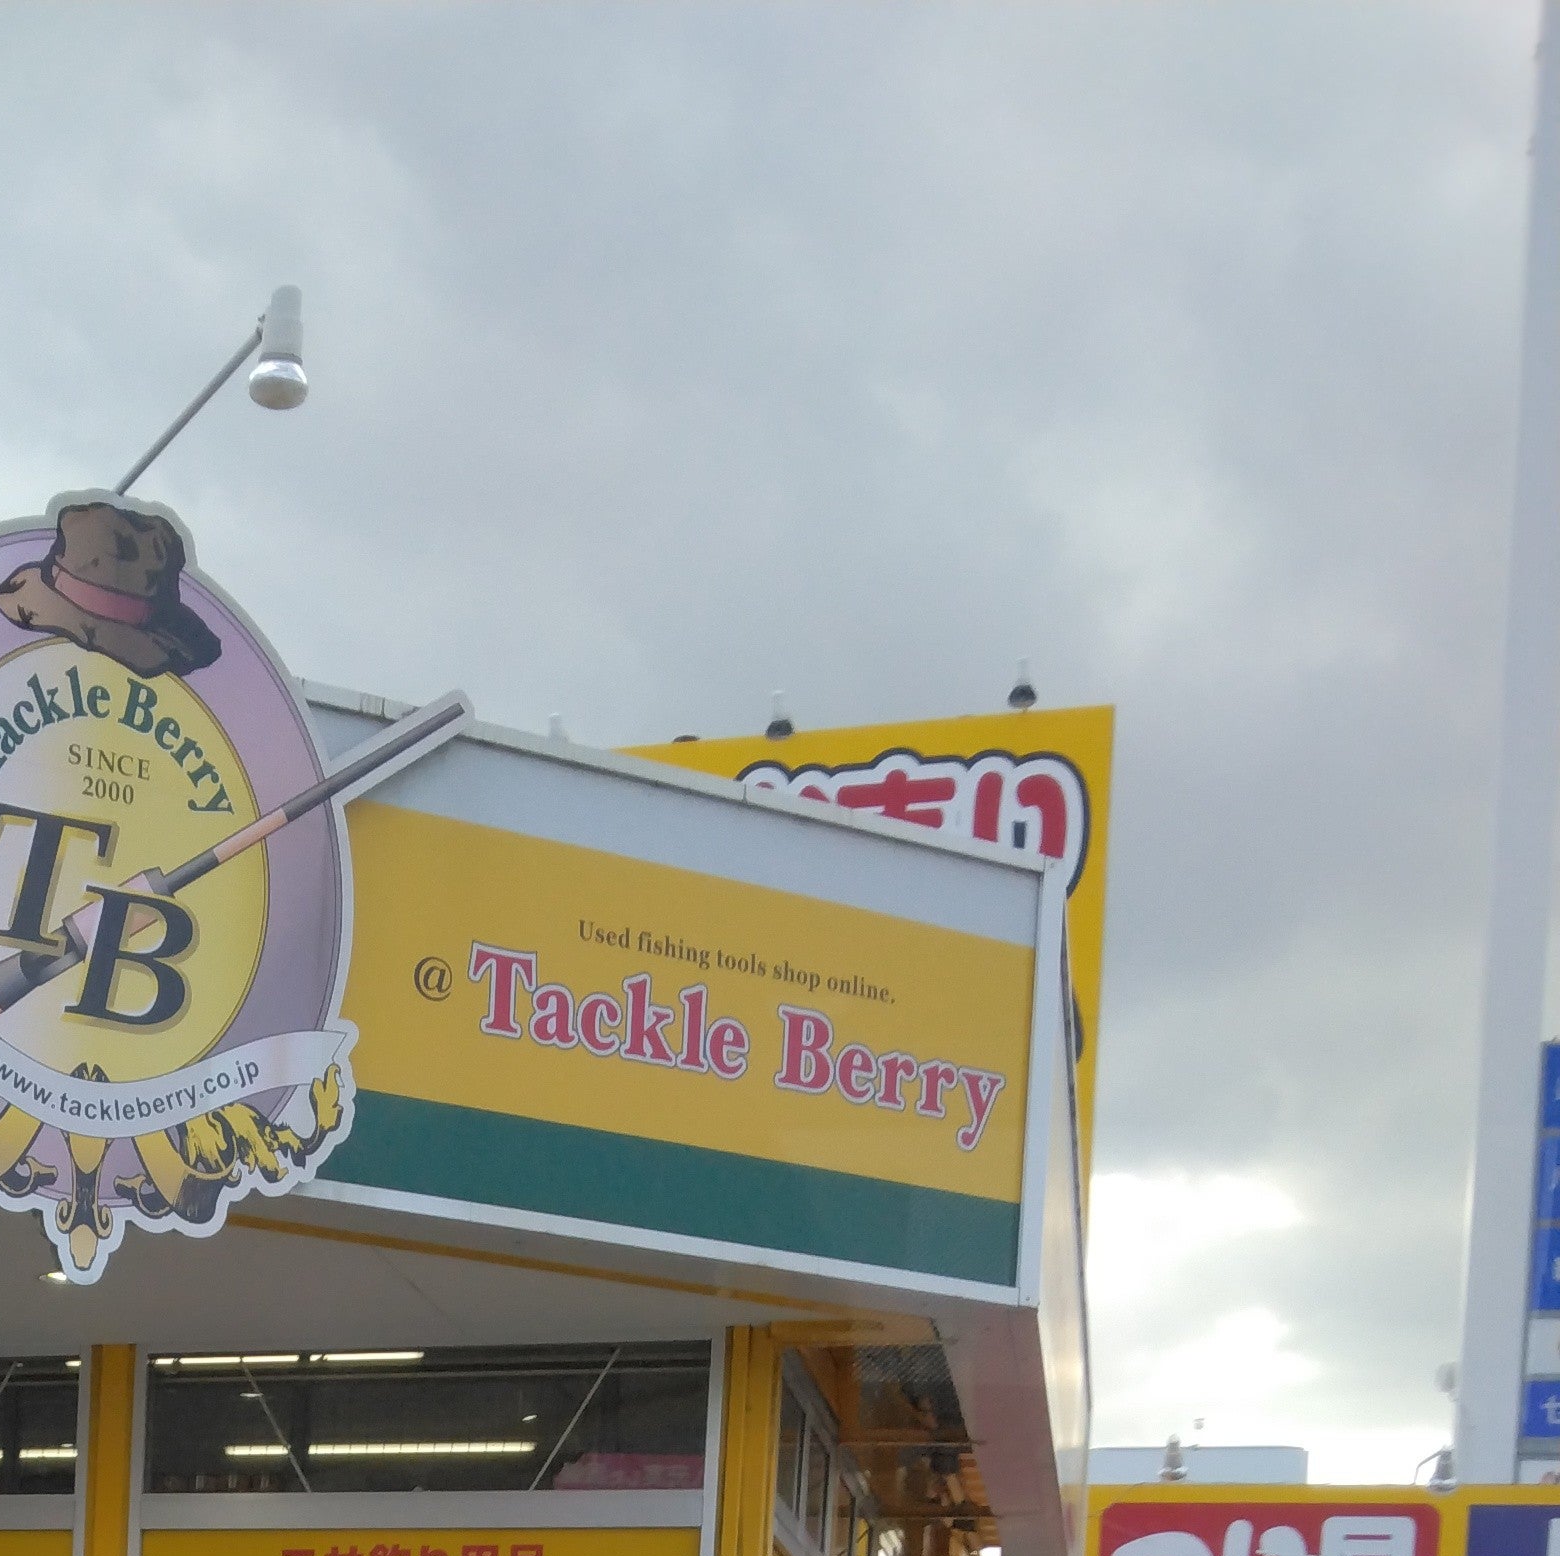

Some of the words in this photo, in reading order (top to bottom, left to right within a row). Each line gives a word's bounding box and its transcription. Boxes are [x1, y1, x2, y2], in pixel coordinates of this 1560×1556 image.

[68, 743, 151, 781] SINCE
[118, 676, 235, 816] Berry
[81, 776, 135, 806] 2000
[577, 919, 631, 950] Used
[637, 930, 711, 970] fishing
[716, 949, 767, 977] tools
[772, 960, 821, 993] shop
[827, 975, 896, 1005] online.
[412, 955, 454, 1002] @
[468, 940, 750, 1081] Tackle
[774, 1004, 1006, 1152] Berry
